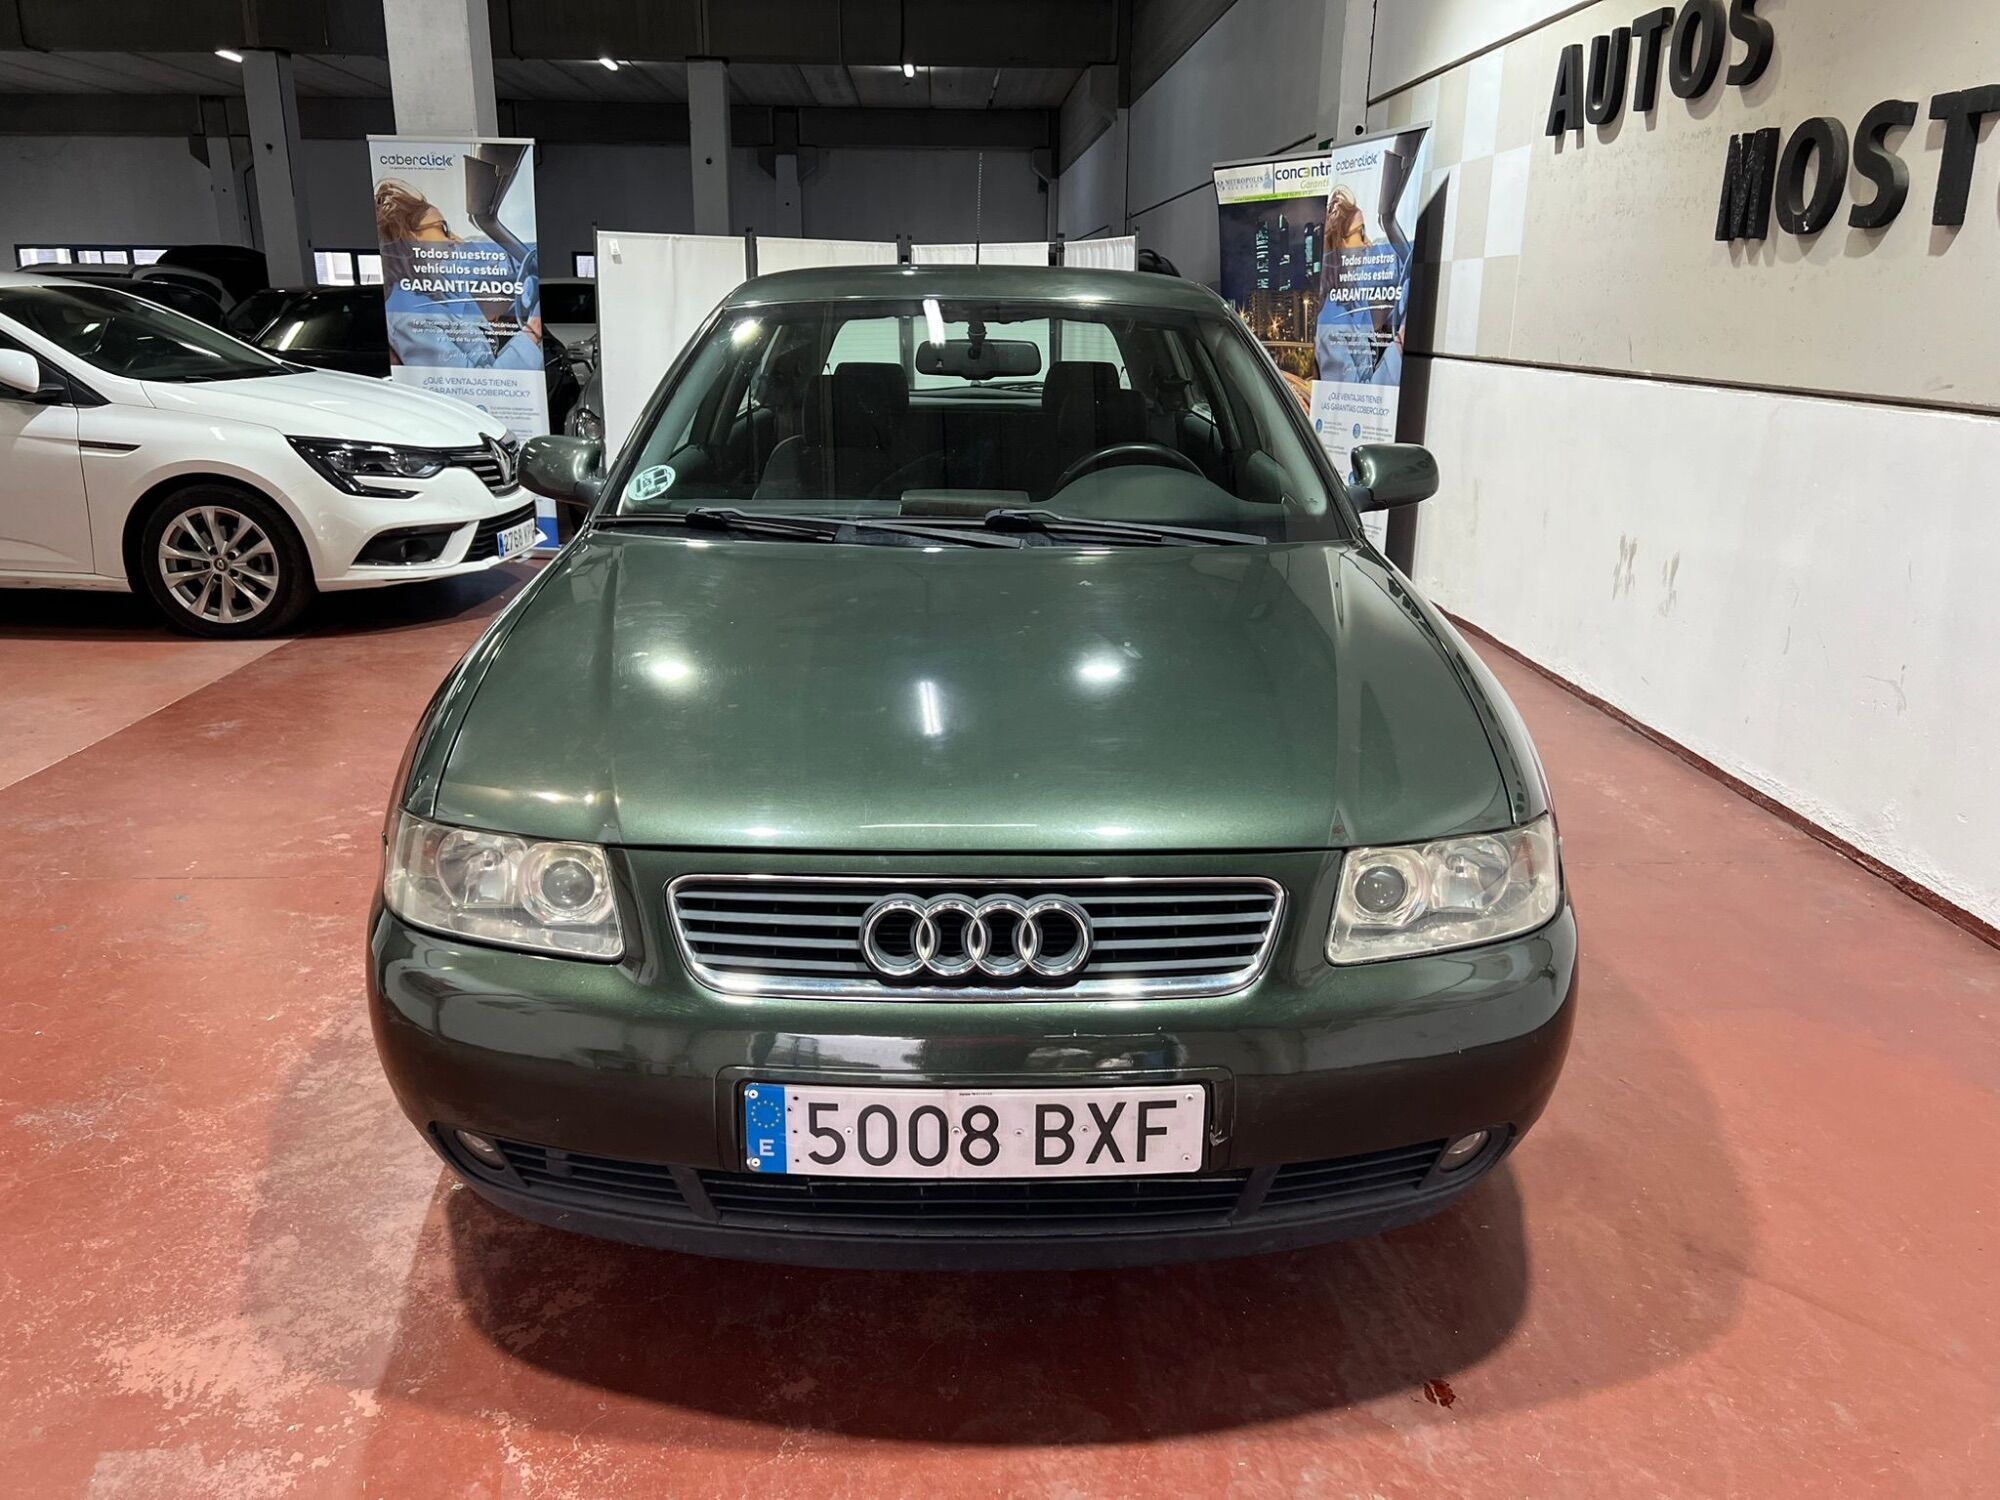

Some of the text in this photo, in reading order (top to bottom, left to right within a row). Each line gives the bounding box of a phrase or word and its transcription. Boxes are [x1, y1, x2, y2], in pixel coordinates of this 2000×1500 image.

[1545, 0, 1774, 136] AUTOS
[1715, 84, 2000, 241] MOST
[1275, 162, 1331, 181] concentr
[412, 247, 506, 260] Todos nuestros
[1341, 253, 1394, 266] Todos nuestros
[413, 263, 507, 276] vehículos están
[400, 278, 525, 295] GARANTIZADOS
[1329, 285, 1402, 302] GARANTIZADOS
[446, 377, 488, 387] VENTAJAS
[489, 378, 518, 387] TIENEN
[759, 1099, 1177, 1167] E 5008 BXF
